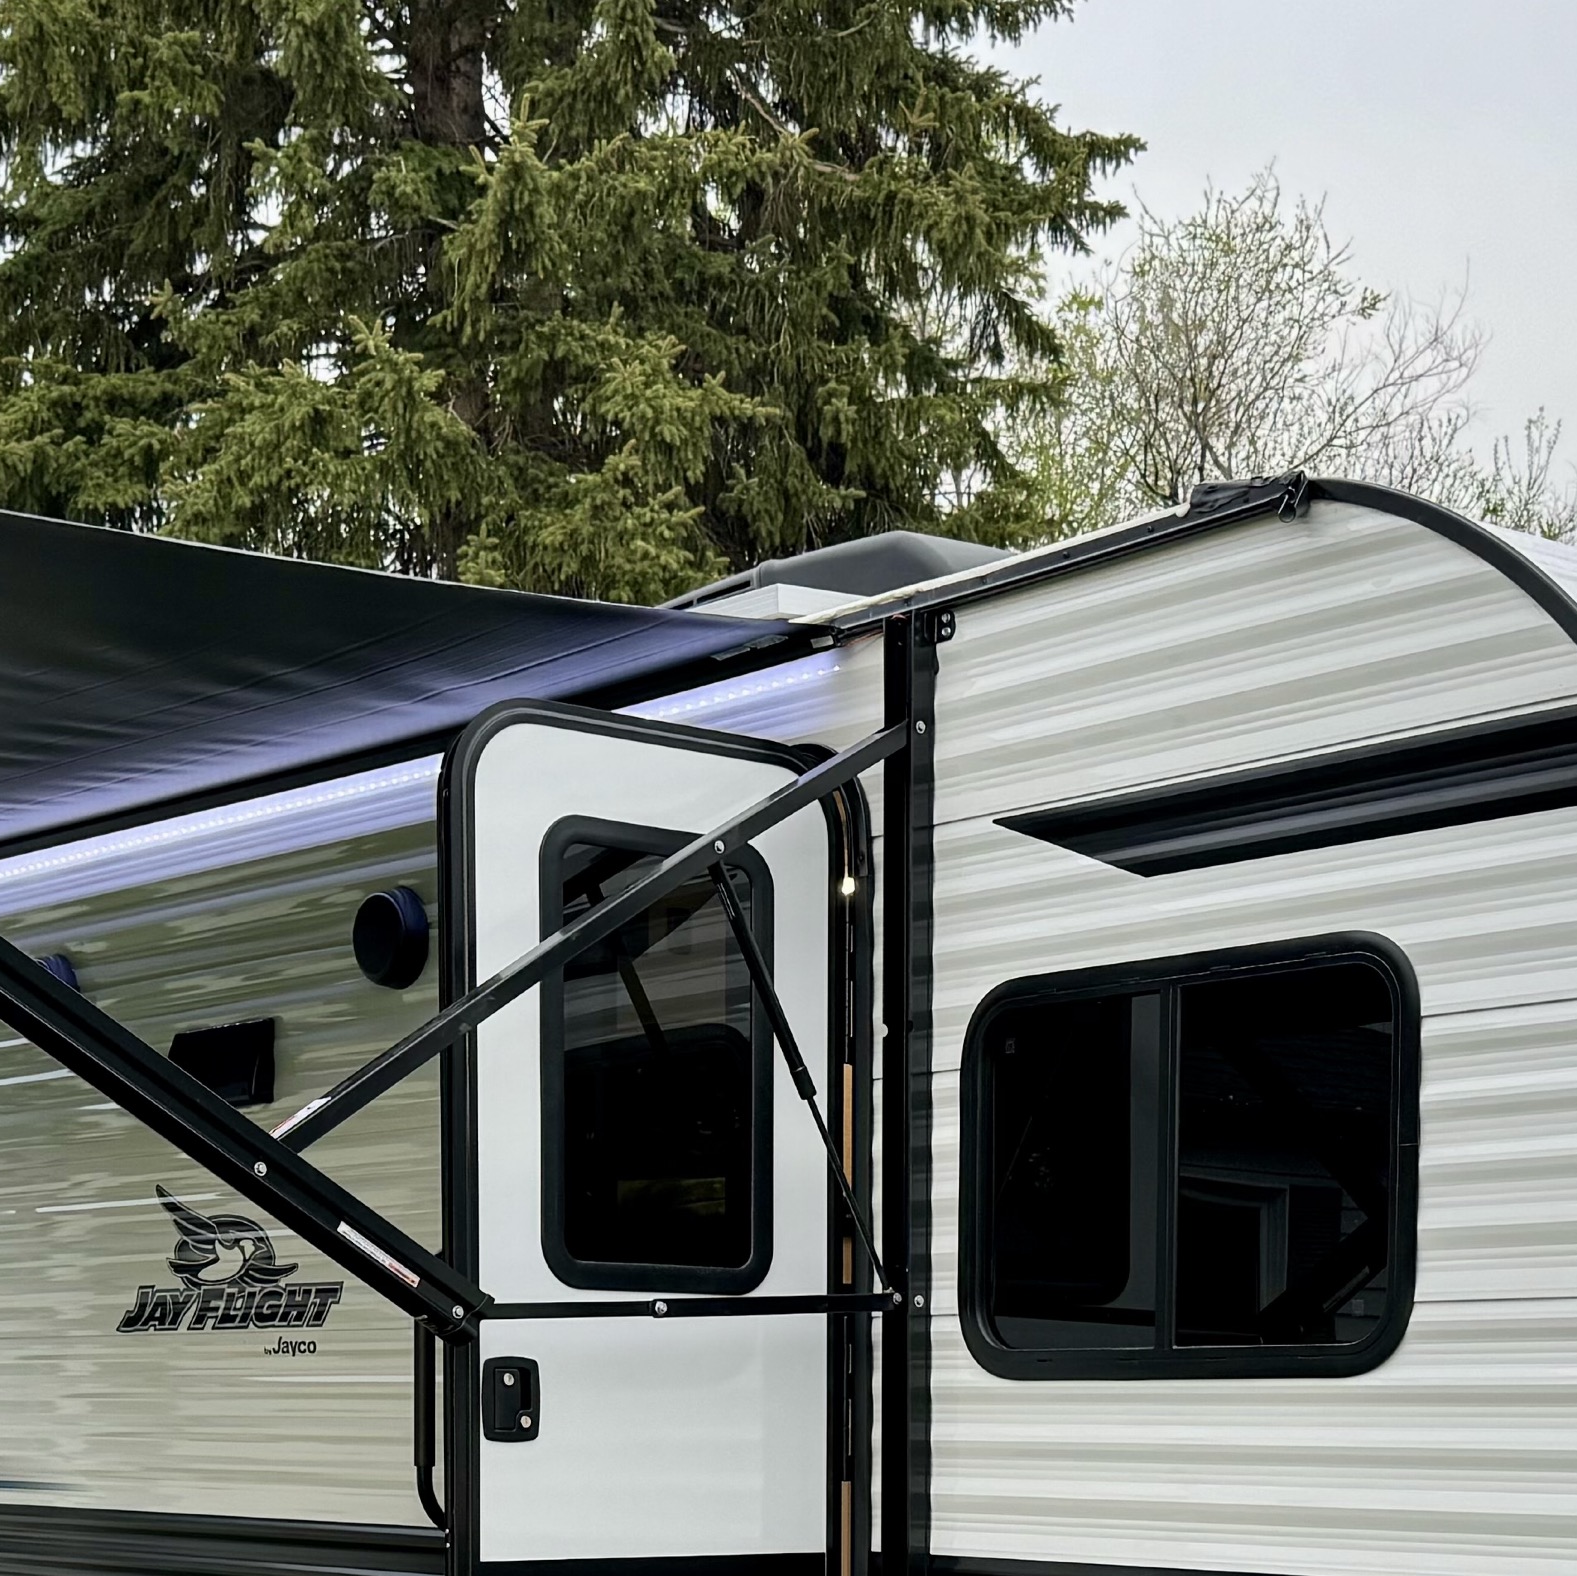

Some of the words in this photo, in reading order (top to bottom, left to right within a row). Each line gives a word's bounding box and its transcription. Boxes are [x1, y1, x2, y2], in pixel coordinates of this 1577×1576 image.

[116, 1285, 200, 1332] JAY
[187, 1281, 344, 1331] FLIGHT
[272, 1336, 317, 1357] Jayco
